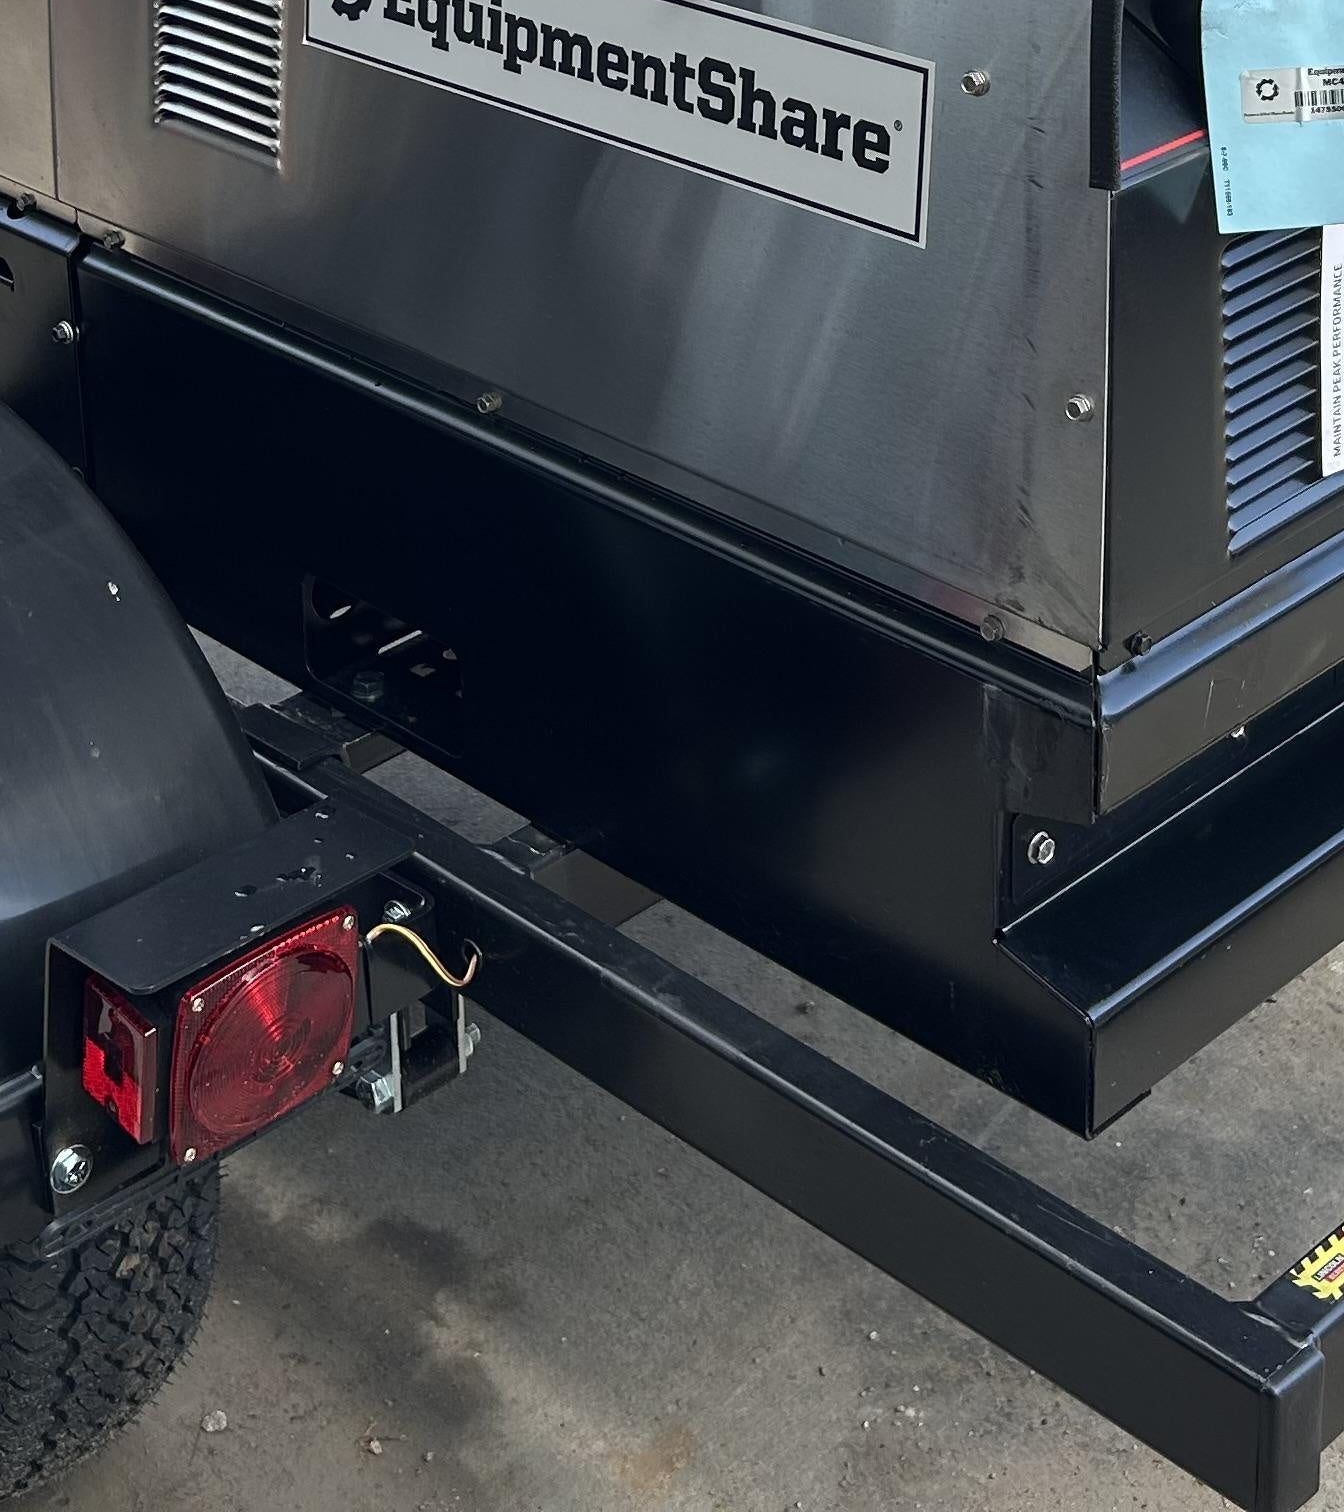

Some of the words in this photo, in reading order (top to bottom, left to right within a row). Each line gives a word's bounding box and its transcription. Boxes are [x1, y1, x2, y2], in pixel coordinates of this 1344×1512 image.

[1333, 263, 1343, 358] PERFORMANCE
[1333, 361, 1342, 392] PEAK
[1333, 395, 1343, 457] MAINTAIN
